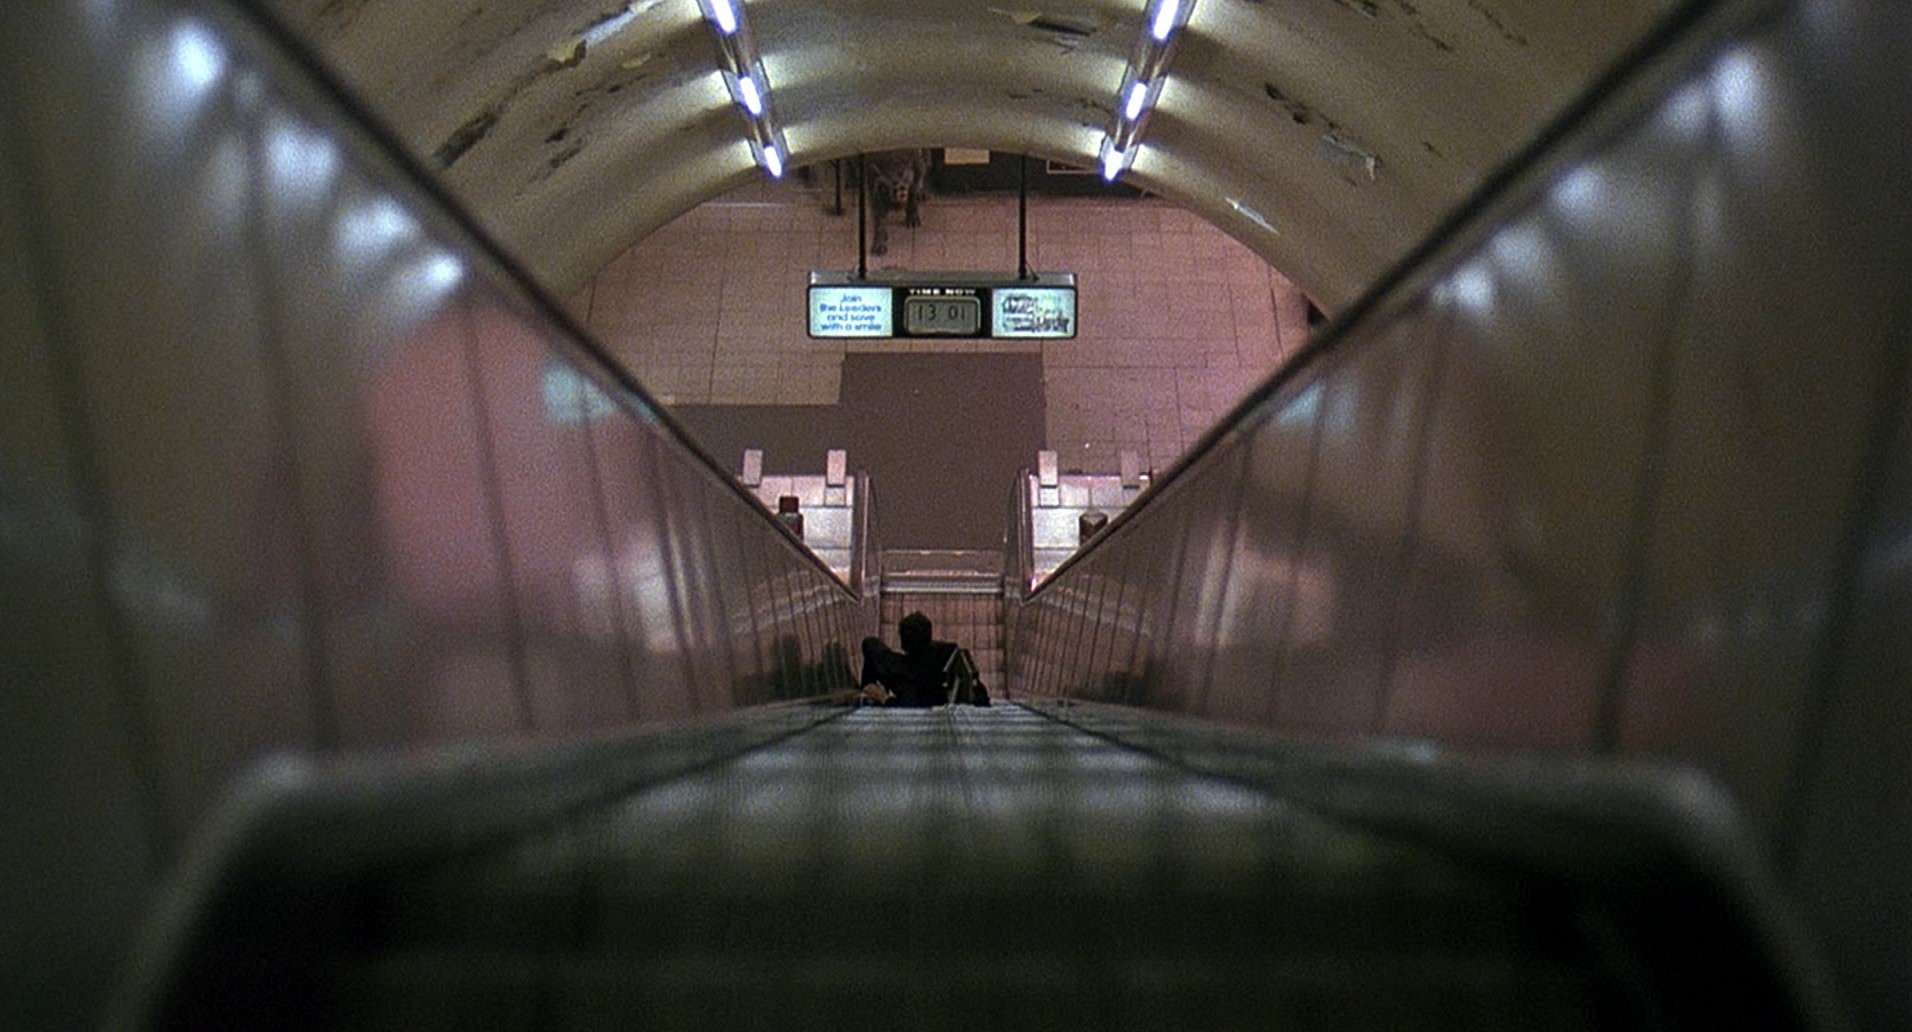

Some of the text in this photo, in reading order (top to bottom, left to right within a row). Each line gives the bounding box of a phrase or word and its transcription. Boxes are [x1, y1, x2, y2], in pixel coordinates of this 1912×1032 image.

[840, 293, 862, 302] Join
[918, 304, 965, 320] 13 01
[827, 313, 848, 321] and
[820, 323, 843, 331] with
[855, 323, 882, 331] smile
